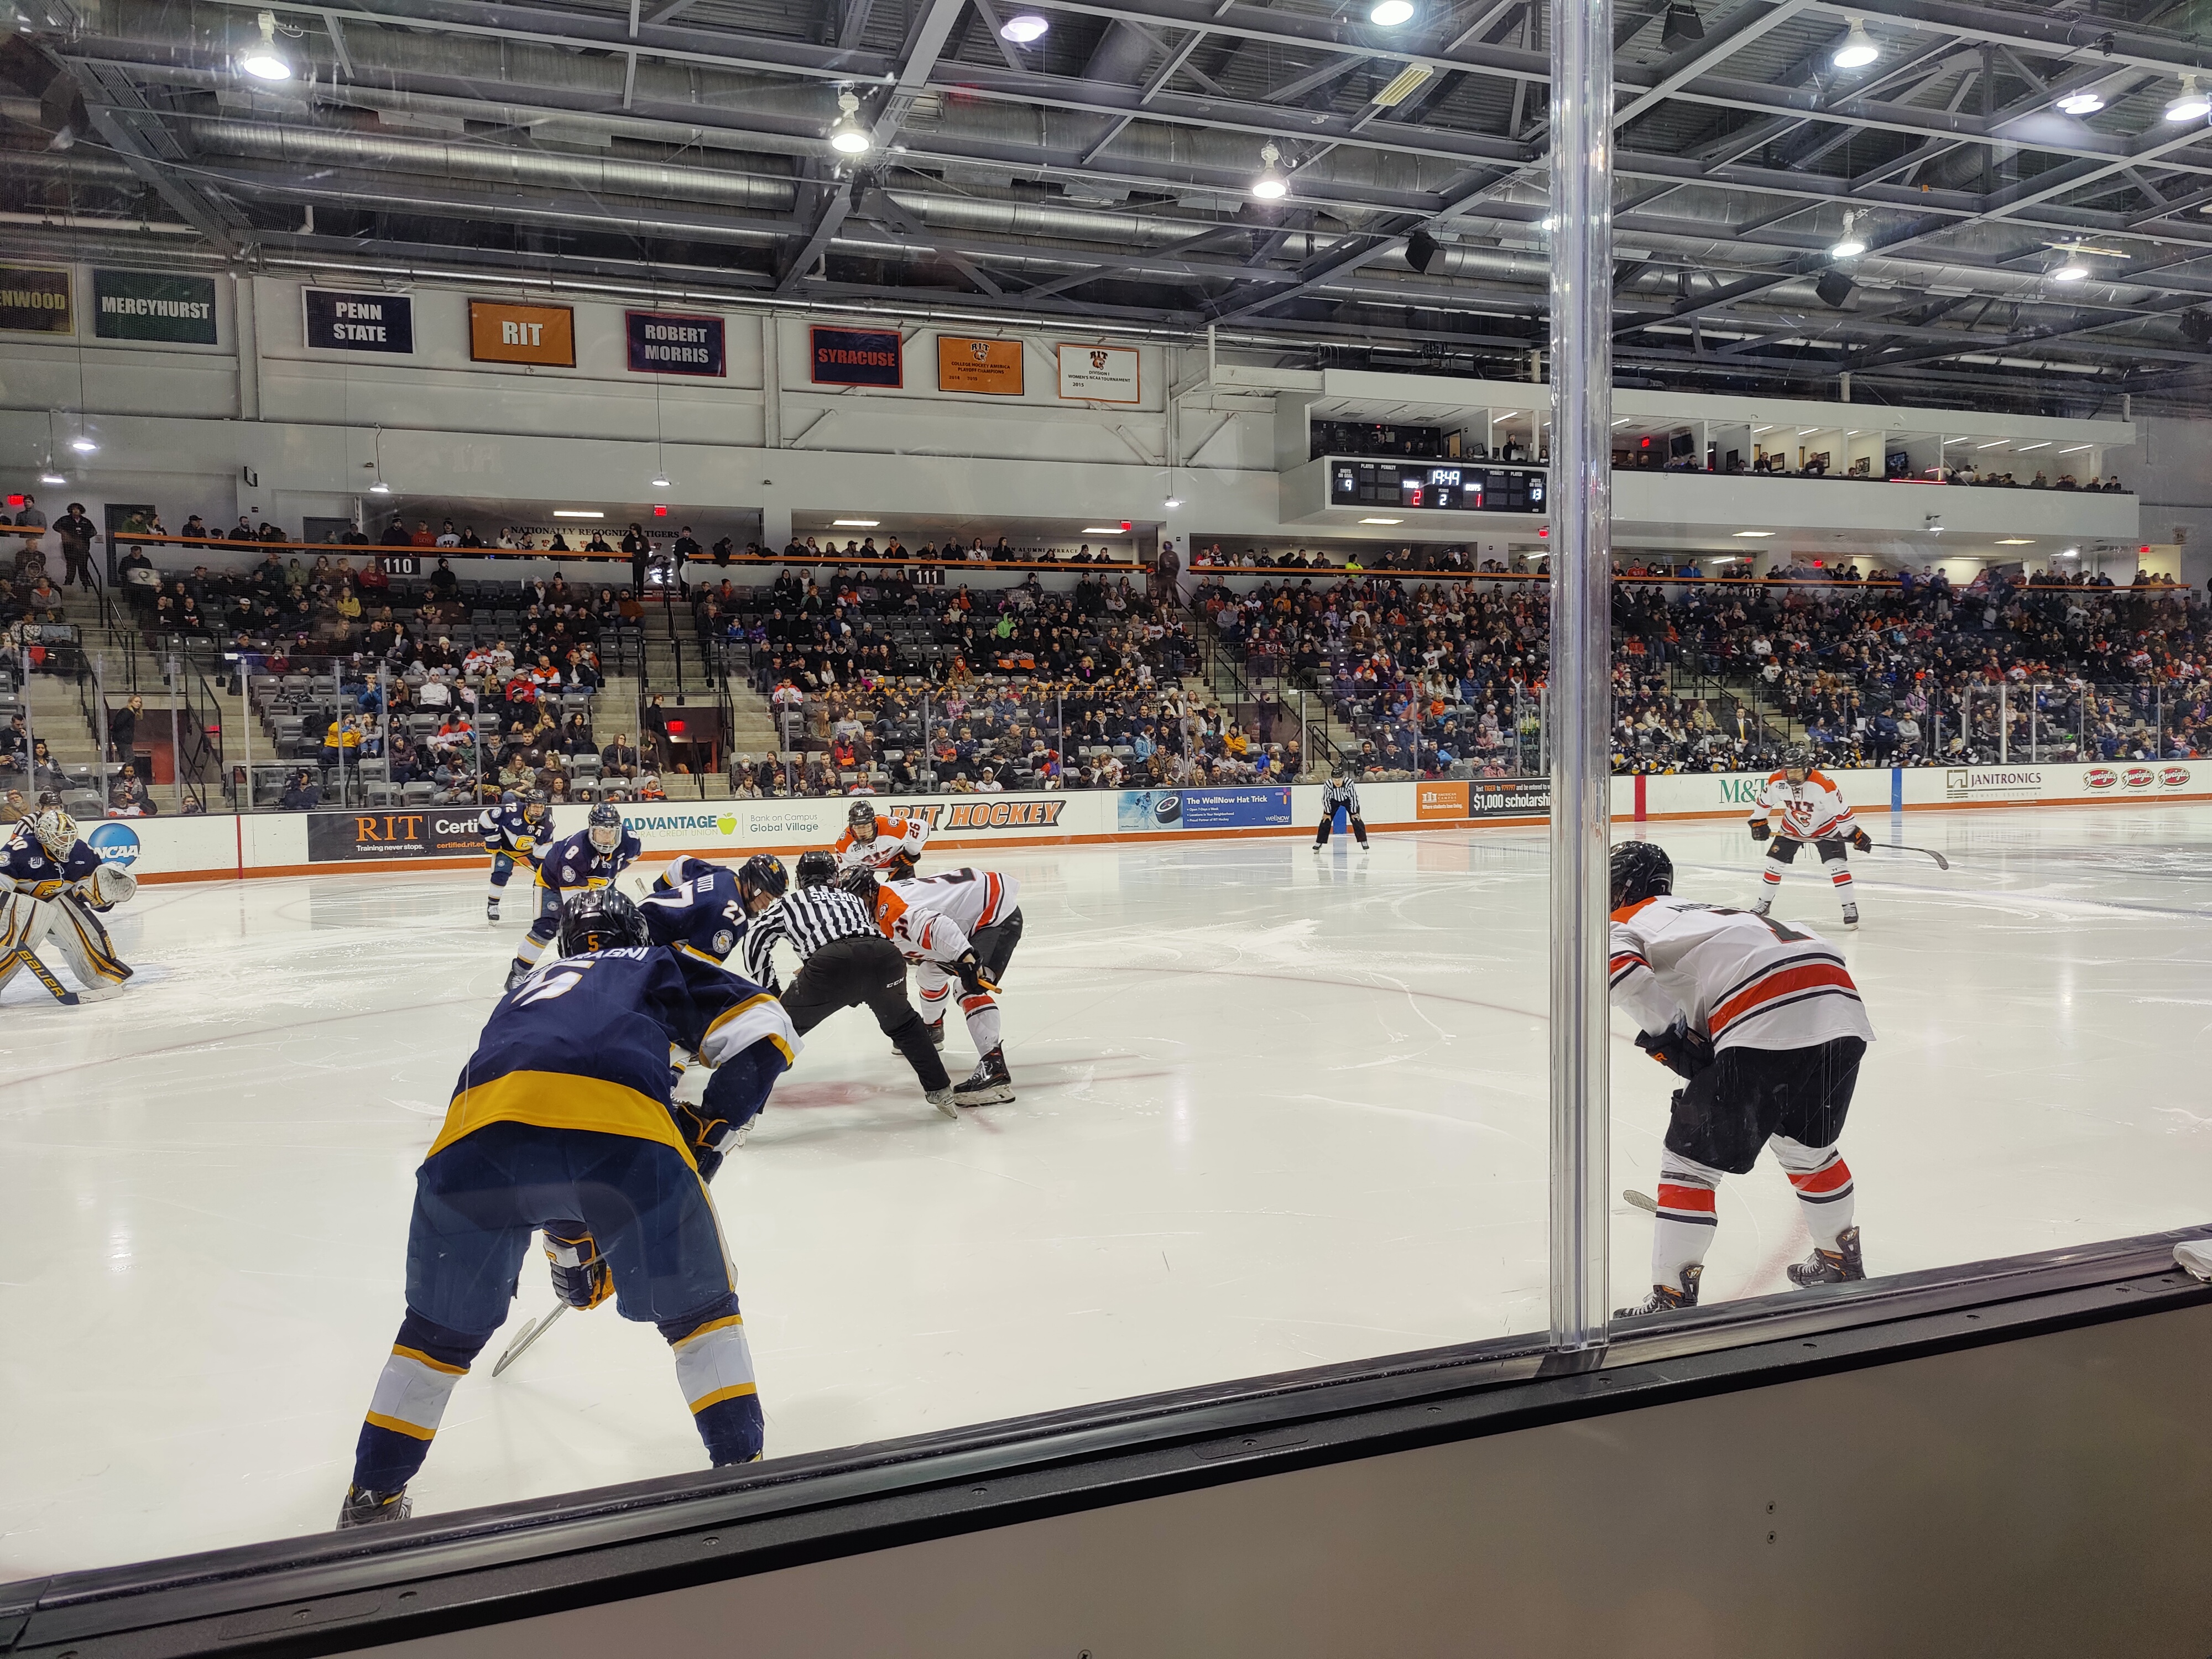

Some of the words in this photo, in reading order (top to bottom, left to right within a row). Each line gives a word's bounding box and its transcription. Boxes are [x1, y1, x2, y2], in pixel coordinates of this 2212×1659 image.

[0, 290, 65, 310] NWOOD
[102, 296, 209, 319] MERCYHURST
[336, 302, 382, 320] PENN
[333, 324, 387, 342] STATE
[502, 321, 544, 347] RIT
[645, 325, 707, 343] ROBERT
[645, 345, 708, 363] MORRIS
[971, 343, 990, 351] RIT
[818, 348, 895, 367] SYRACUSE
[1090, 351, 1108, 359] RIT
[1345, 479, 1352, 491] 9
[1432, 471, 1460, 486] 19:49
[1413, 490, 1421, 505] 2
[1439, 494, 1447, 505] 2
[1477, 494, 1480, 507] 1
[1532, 489, 1542, 500] 13
[511, 526, 575, 535] NATIONALLY
[578, 528, 632, 537] RECOGNIZ
[384, 558, 412, 573] 110
[917, 570, 938, 585] 111
[671, 721, 682, 730] EXIT
[1971, 773, 2041, 787] JANITRONICS
[505, 802, 517, 812] 72
[1474, 793, 1504, 811] $1,000
[1505, 792, 1551, 807] scholarshi
[784, 813, 817, 822] Campus
[946, 801, 1065, 830] HOCKEY
[355, 816, 423, 842] RIT
[435, 819, 478, 834] Certi
[623, 816, 717, 831] ADVANTAGE
[750, 822, 783, 832] Global
[785, 822, 818, 832] Village
[909, 822, 920, 839] 26
[535, 828, 542, 837] A
[691, 828, 718, 837] UNION
[94, 845, 140, 859] NCAA
[565, 845, 579, 859] 8
[32, 857, 40, 865] 20
[811, 891, 858, 904] SHEMO
[722, 900, 747, 926] 27
[895, 919, 911, 942] 21
[588, 935, 599, 952] 5
[18, 950, 65, 997] BAUER
[510, 959, 596, 1006] 5
